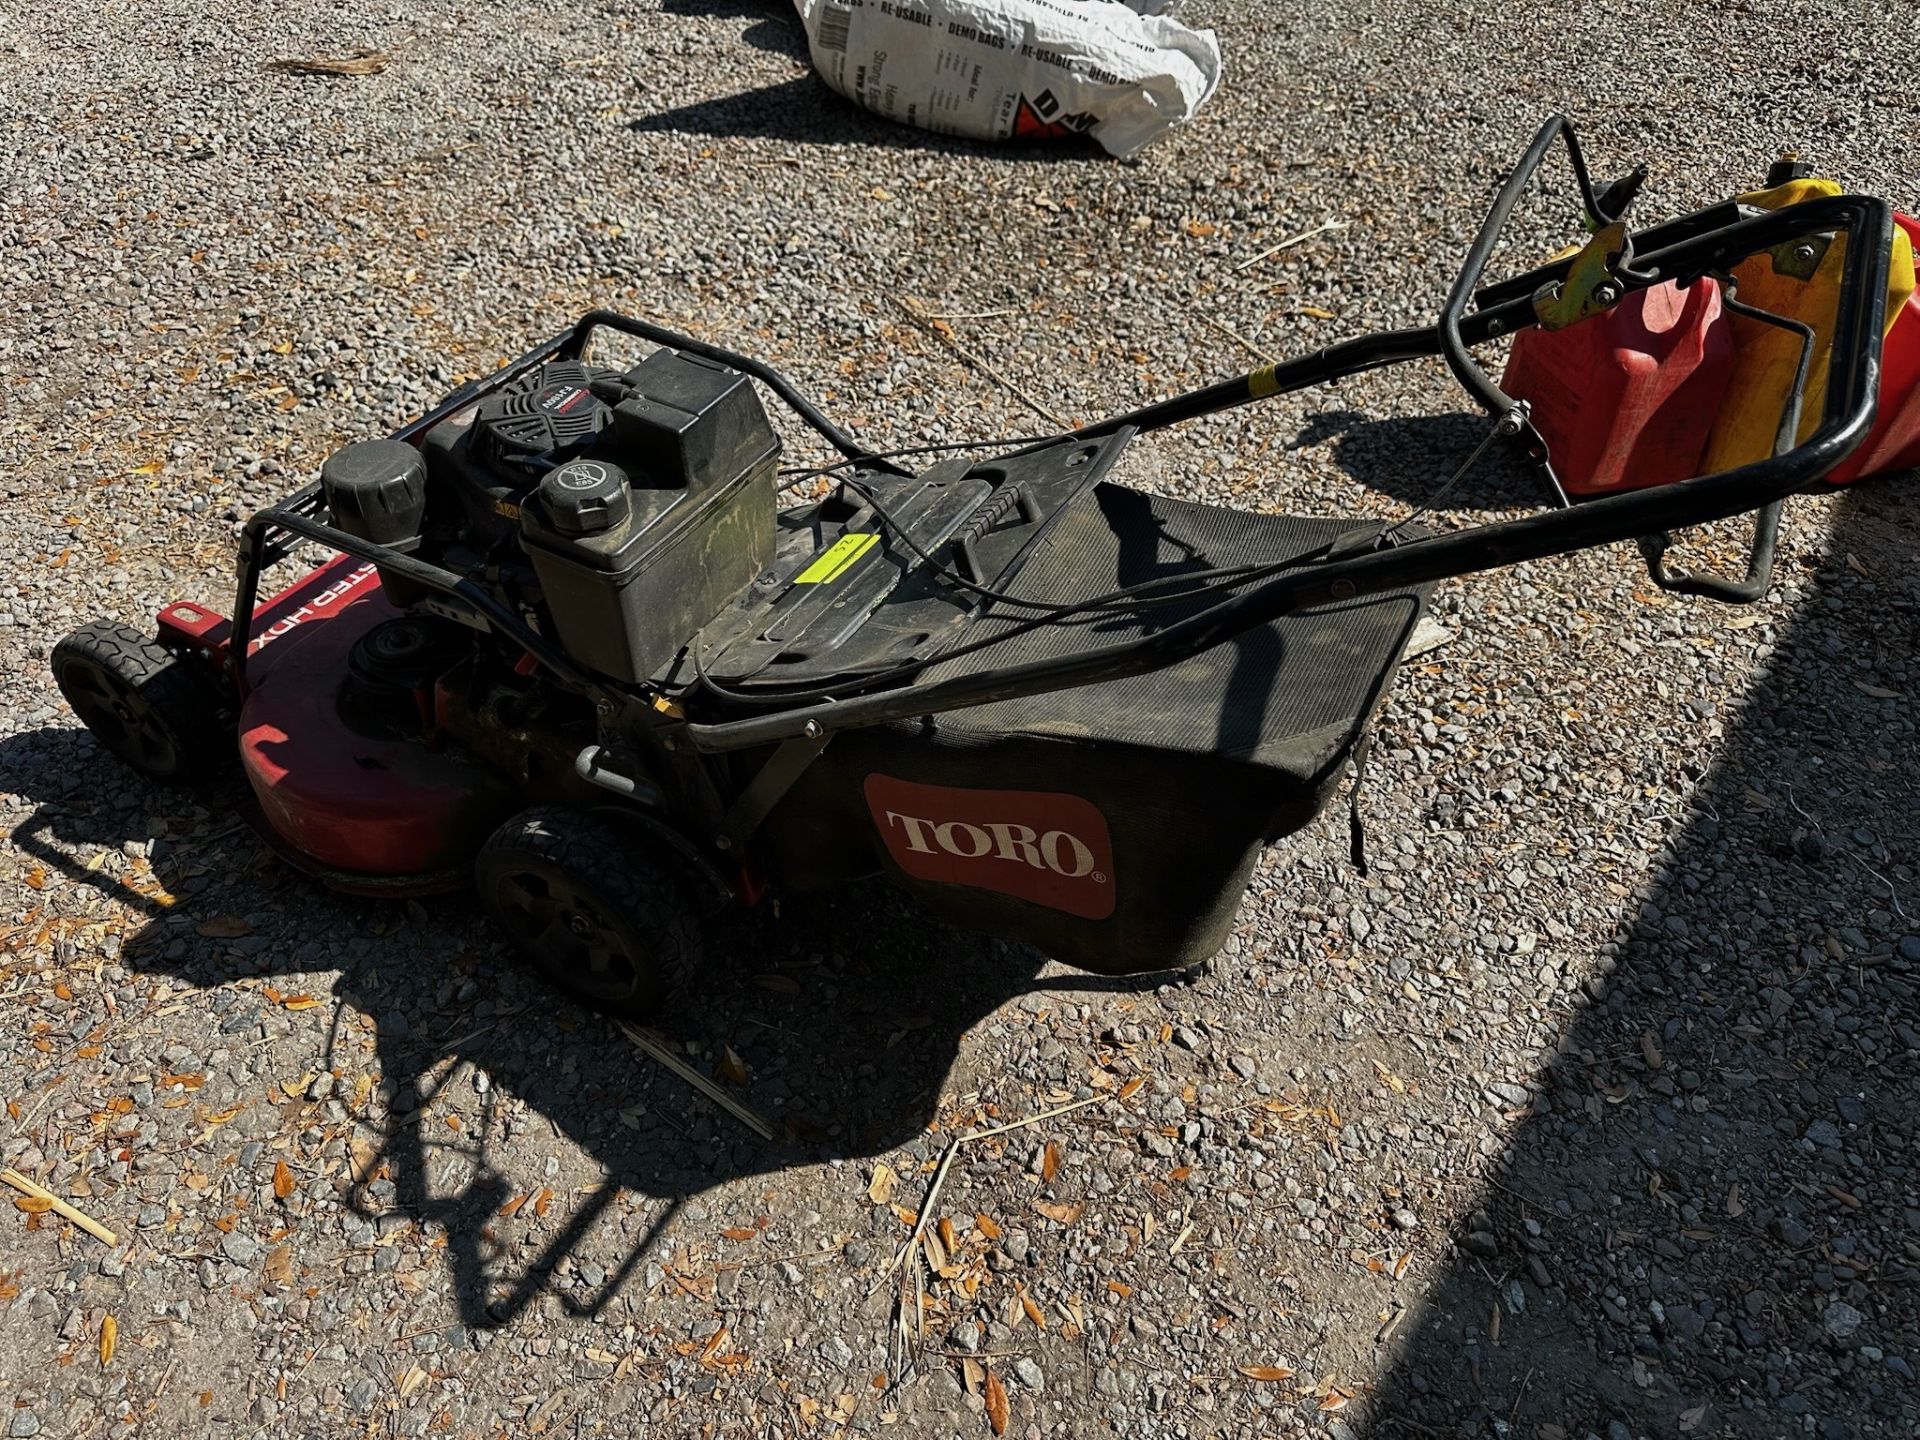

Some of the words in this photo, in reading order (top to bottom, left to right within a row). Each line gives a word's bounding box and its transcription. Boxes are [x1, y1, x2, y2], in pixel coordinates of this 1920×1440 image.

[881, 3, 933, 28] RE-USABLE
[948, 22, 977, 42] DEMO
[977, 29, 1006, 50] BAGS
[1021, 44, 1073, 71] RE-USABLE
[1088, 66, 1118, 86] DEMO
[867, 50, 888, 86] Strong
[999, 92, 1016, 124] Tear
[251, 606, 314, 650] HDX
[886, 810, 1094, 877] TORO
